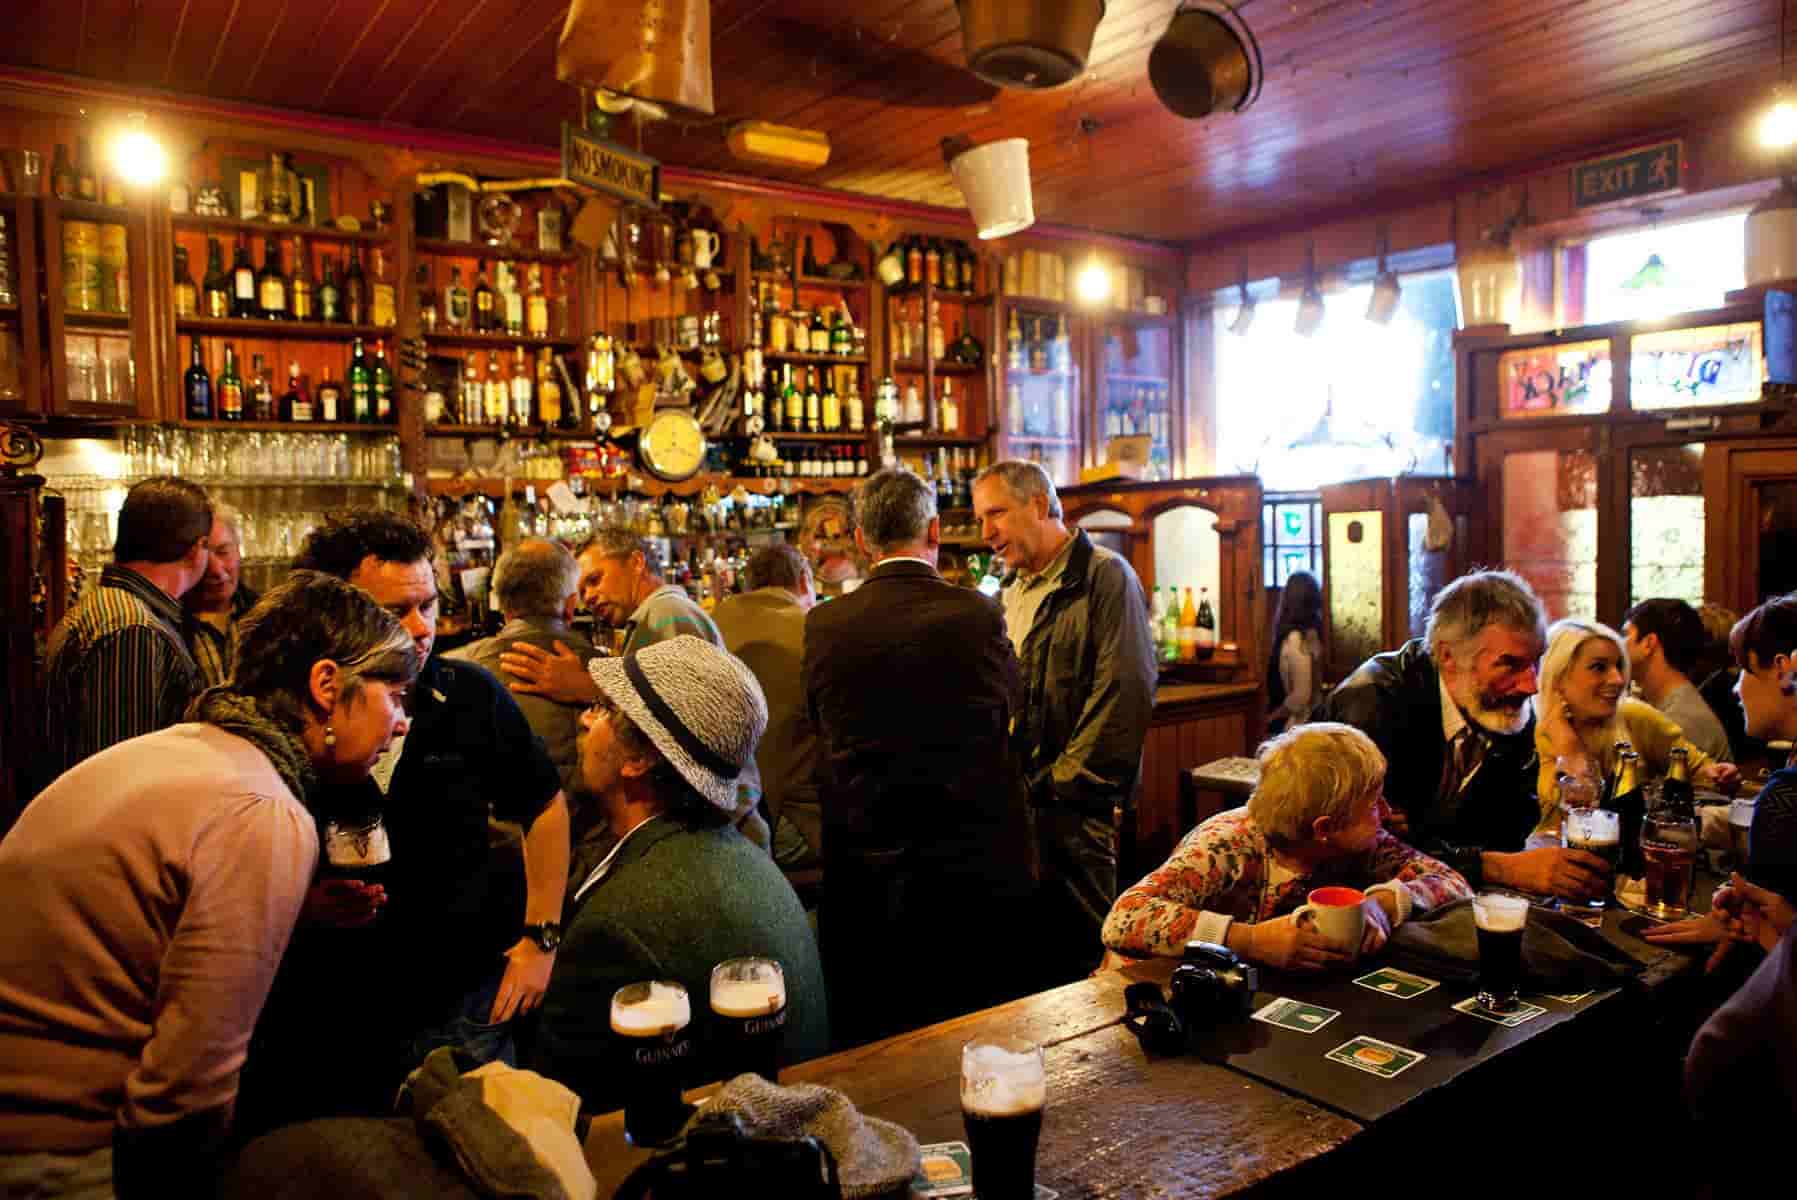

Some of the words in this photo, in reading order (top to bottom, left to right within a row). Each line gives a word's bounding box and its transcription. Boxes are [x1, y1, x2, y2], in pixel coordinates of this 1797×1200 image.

[572, 141, 591, 175] NO
[592, 148, 652, 194] SMOKING
[1583, 161, 1640, 196] EXIT
